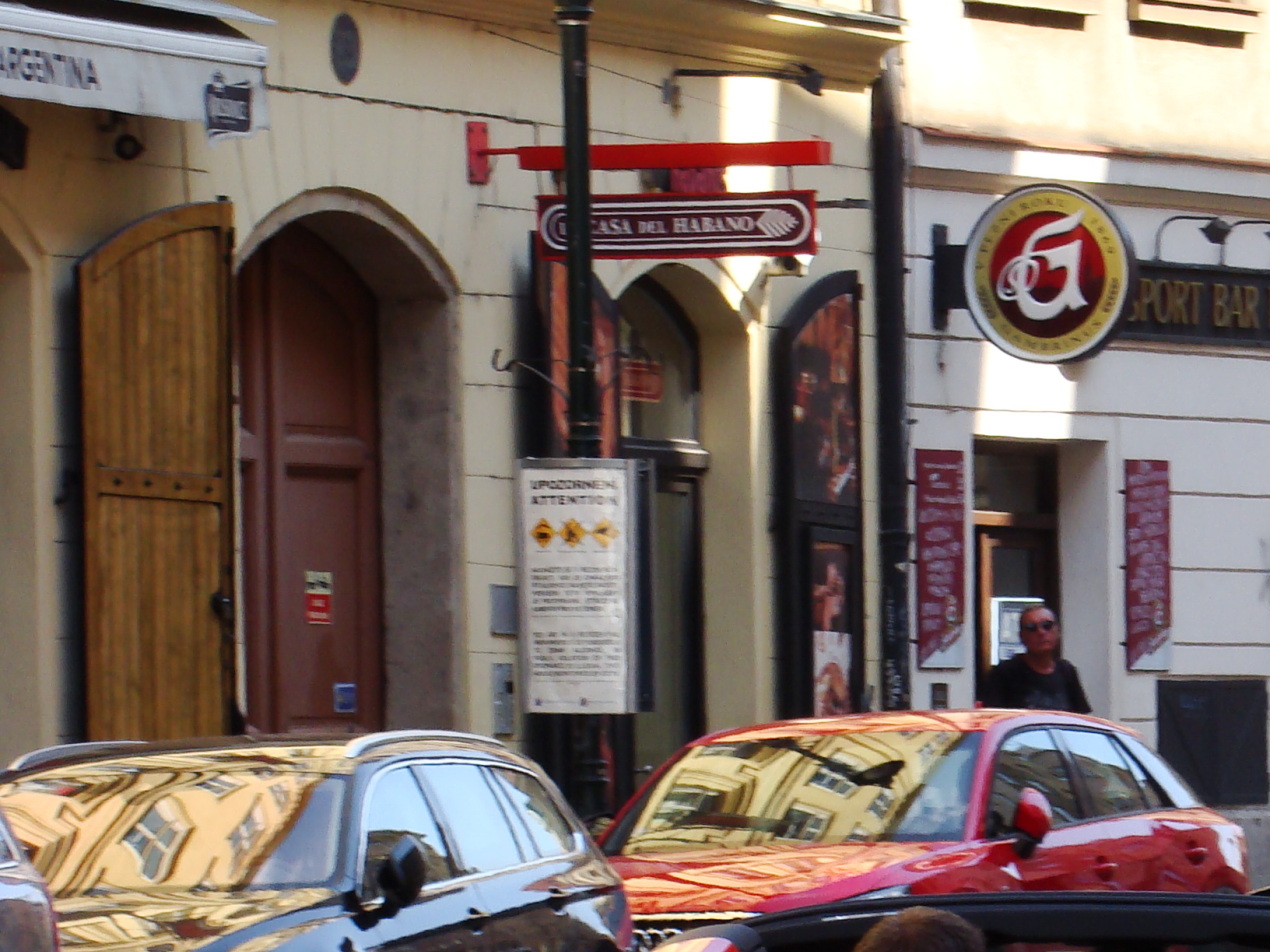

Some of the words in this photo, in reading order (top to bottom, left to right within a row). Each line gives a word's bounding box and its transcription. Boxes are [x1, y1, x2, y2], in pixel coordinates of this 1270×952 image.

[637, 220, 668, 234] DEL
[671, 216, 755, 234] HABANO
[1211, 283, 1260, 329] BAR
[530, 495, 619, 506] ATTENTION
